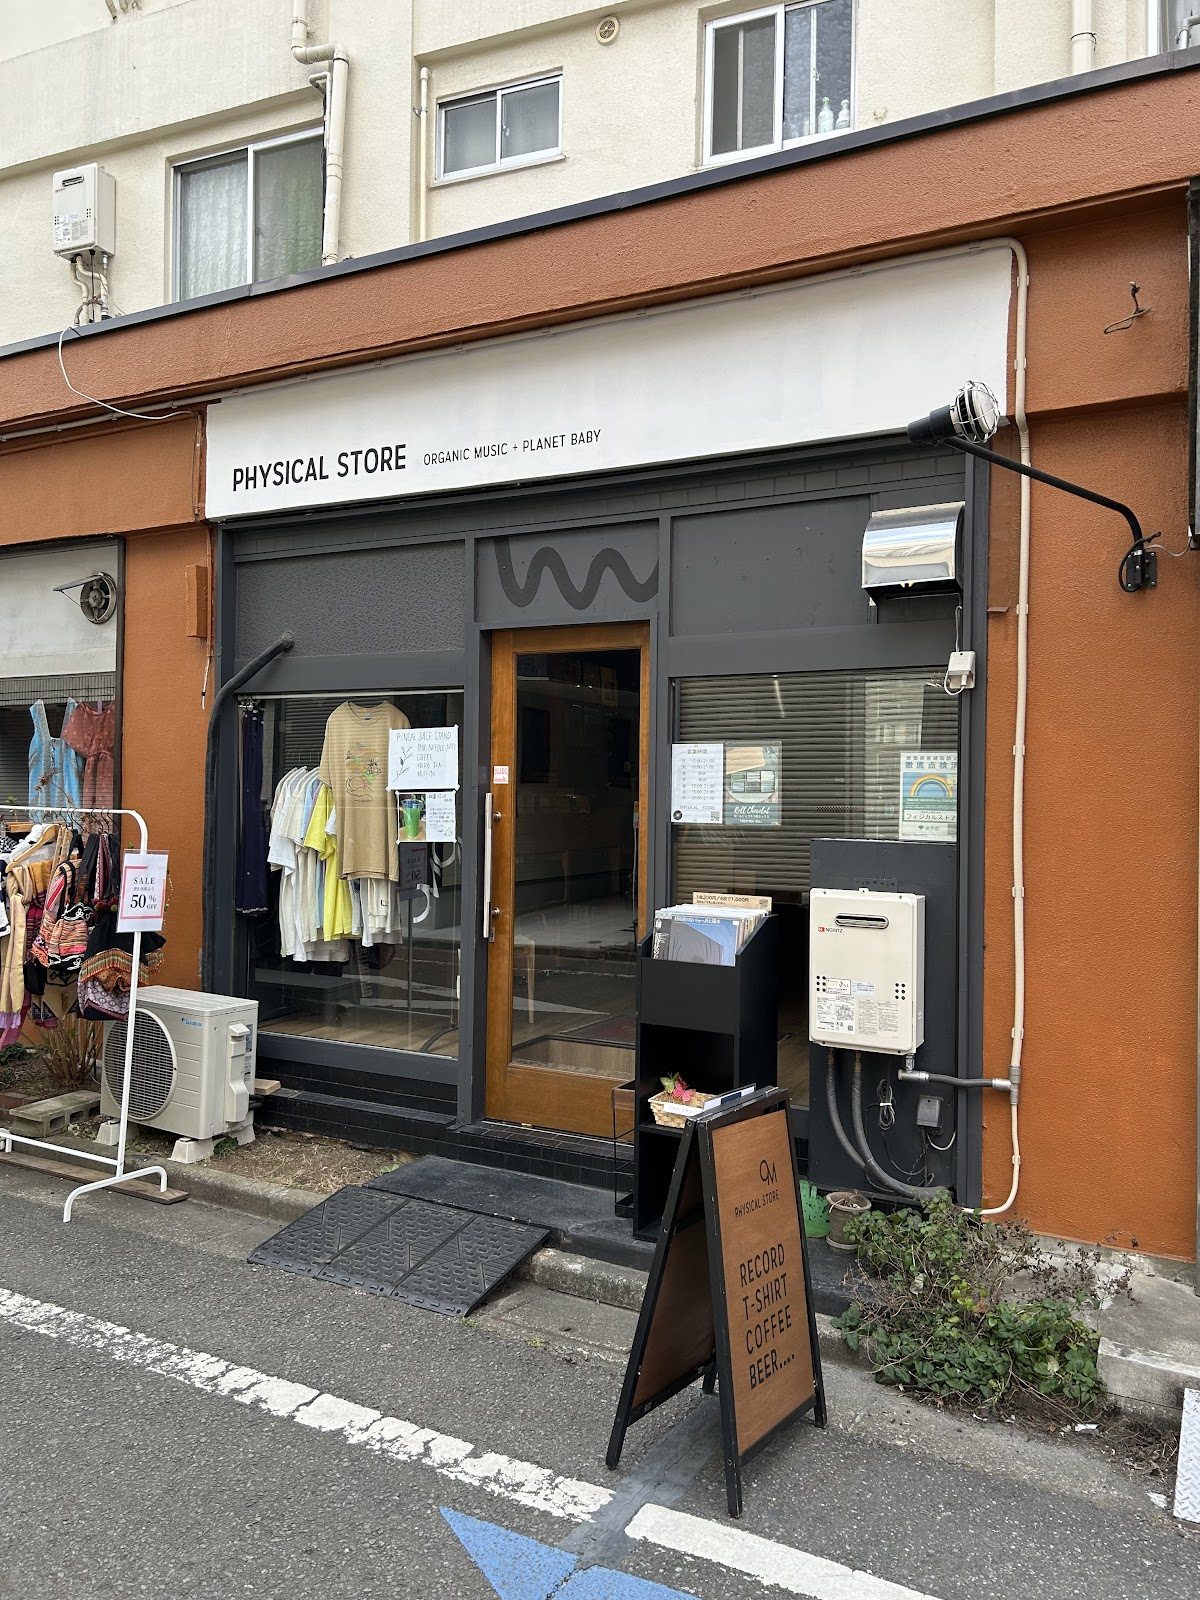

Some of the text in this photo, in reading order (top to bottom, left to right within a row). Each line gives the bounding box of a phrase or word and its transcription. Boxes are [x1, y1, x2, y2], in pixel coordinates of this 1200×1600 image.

[233, 444, 406, 492] PHYSICAL STORE
[423, 448, 470, 466] ORGANIC
[474, 443, 508, 459] MUSIC
[522, 434, 566, 452] PLANET
[571, 429, 601, 446] BABY
[435, 731, 452, 741] STAND
[133, 876, 155, 885] SALE
[734, 1189, 779, 1219] PHYSICAL STORE
[739, 1243, 785, 1288] RECORD
[742, 1272, 787, 1320] T-SHIRT
[746, 1304, 792, 1355] COFFEE
